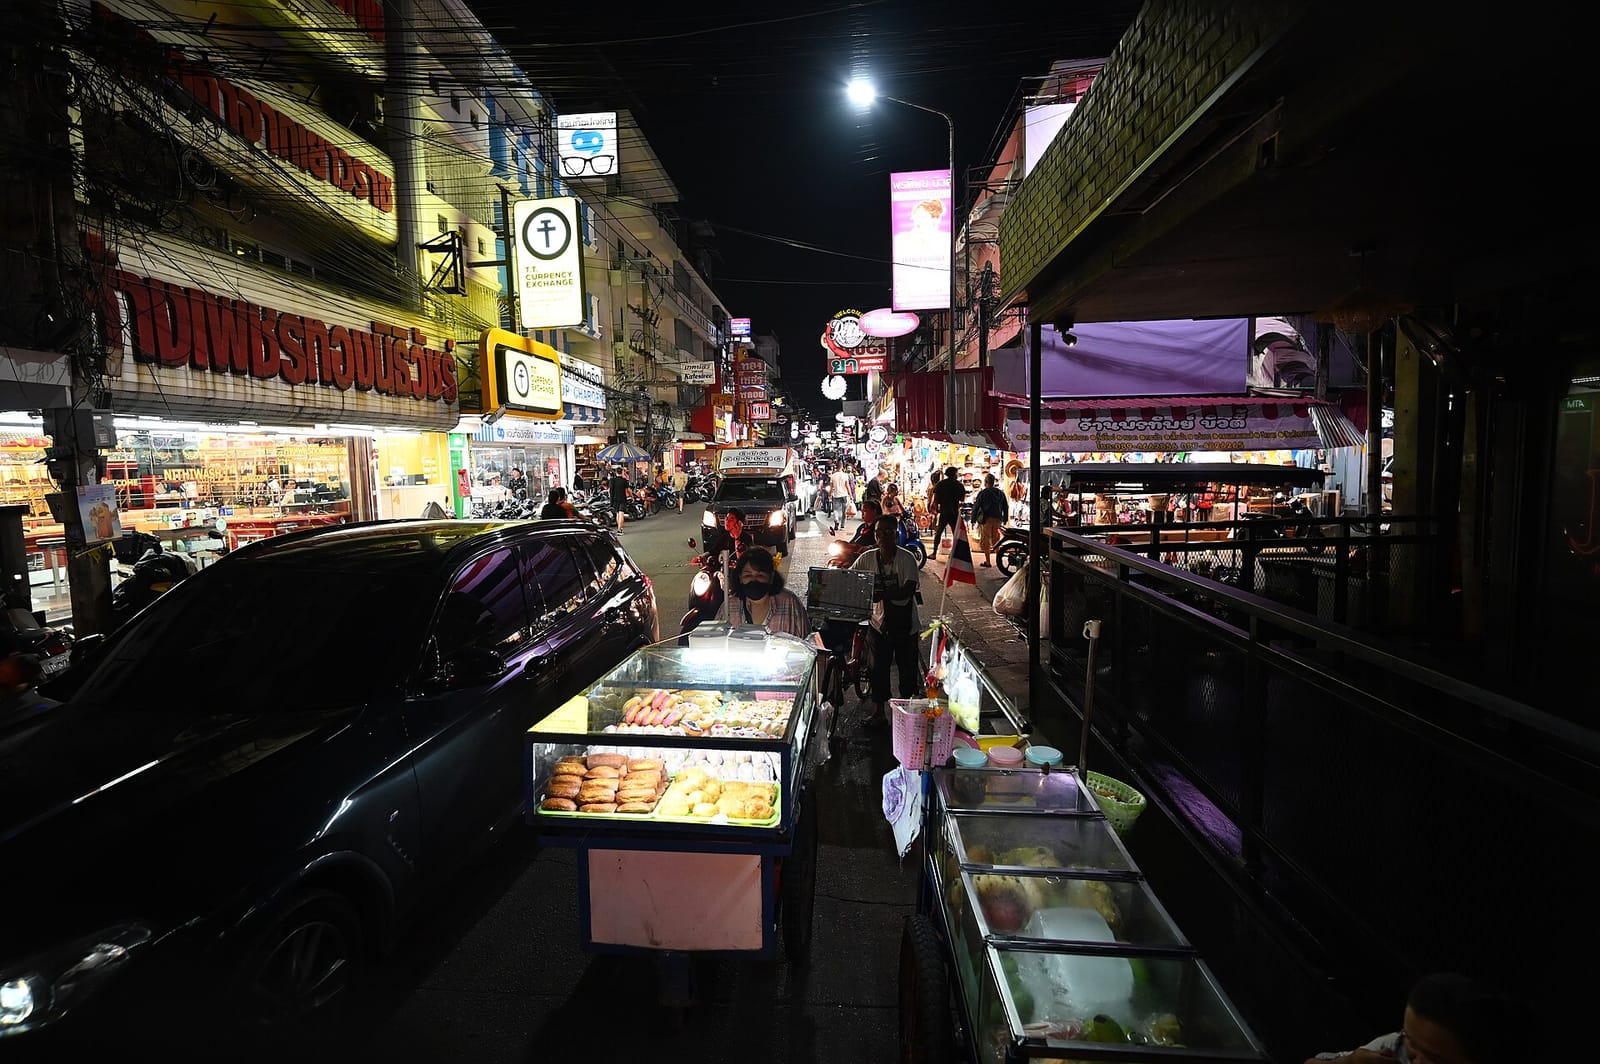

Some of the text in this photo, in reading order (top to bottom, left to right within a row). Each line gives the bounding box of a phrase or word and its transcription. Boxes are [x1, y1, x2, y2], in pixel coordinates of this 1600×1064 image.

[525, 271, 573, 281] CURRENCY
[526, 278, 574, 288] EXCHANGE
[831, 358, 858, 373] ยา
